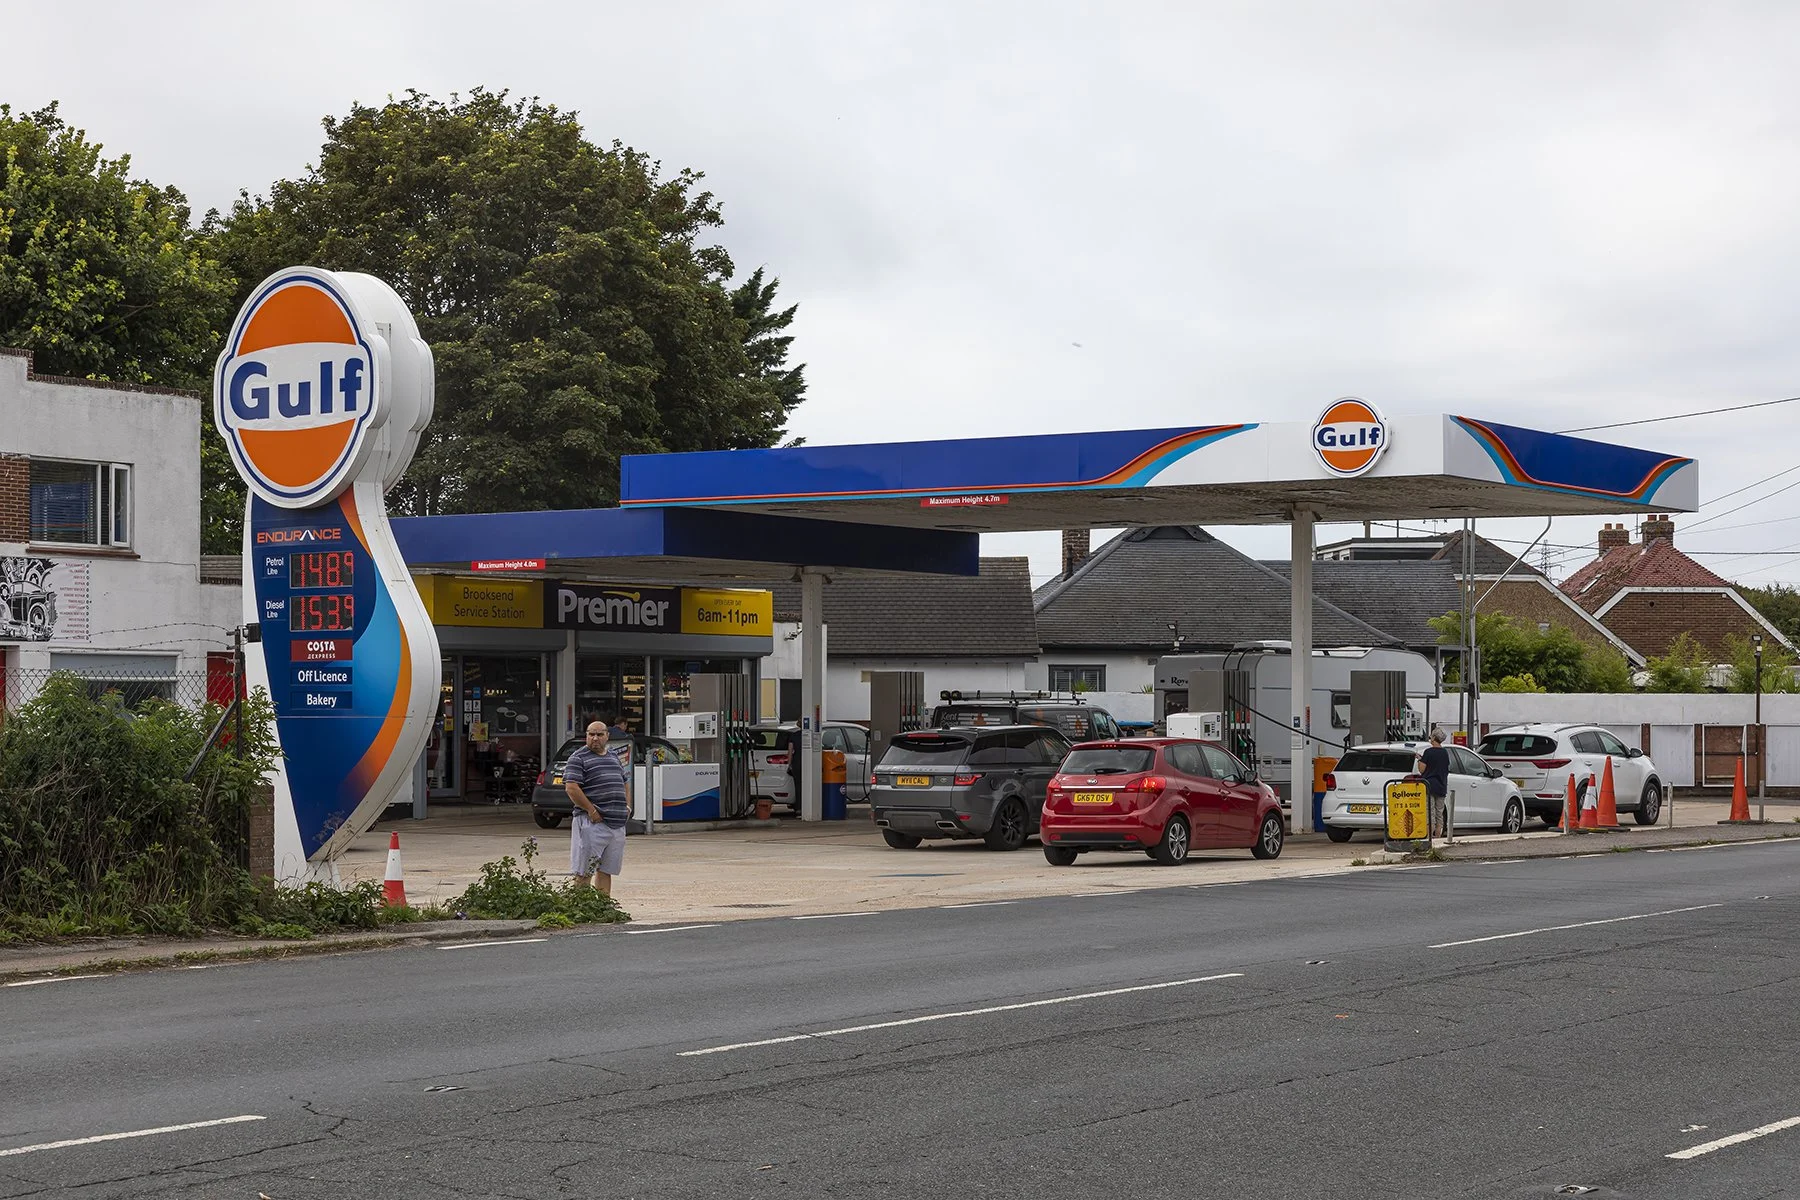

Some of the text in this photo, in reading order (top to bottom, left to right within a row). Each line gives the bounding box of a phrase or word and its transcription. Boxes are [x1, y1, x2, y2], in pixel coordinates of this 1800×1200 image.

[229, 358, 364, 420] Gulf
[1317, 427, 1381, 447] Gulf
[929, 495, 1000, 505] Maximum Height 4.7m
[256, 528, 342, 544] ENDURANCE
[265, 557, 285, 567] Petrol
[505, 561, 523, 569] Height
[523, 560, 538, 568] 4.0m
[267, 567, 279, 576] Litre
[463, 586, 514, 601] Brooksend
[265, 600, 285, 610] Diesel
[557, 588, 669, 627] Premier
[267, 611, 279, 619] Litre
[454, 604, 525, 620] Service Station
[697, 607, 759, 626] 6am-11pm
[307, 641, 336, 652] COSTA
[298, 670, 348, 682] Off Licence
[306, 694, 337, 708] Bakery
[1392, 790, 1422, 800] Rollover
